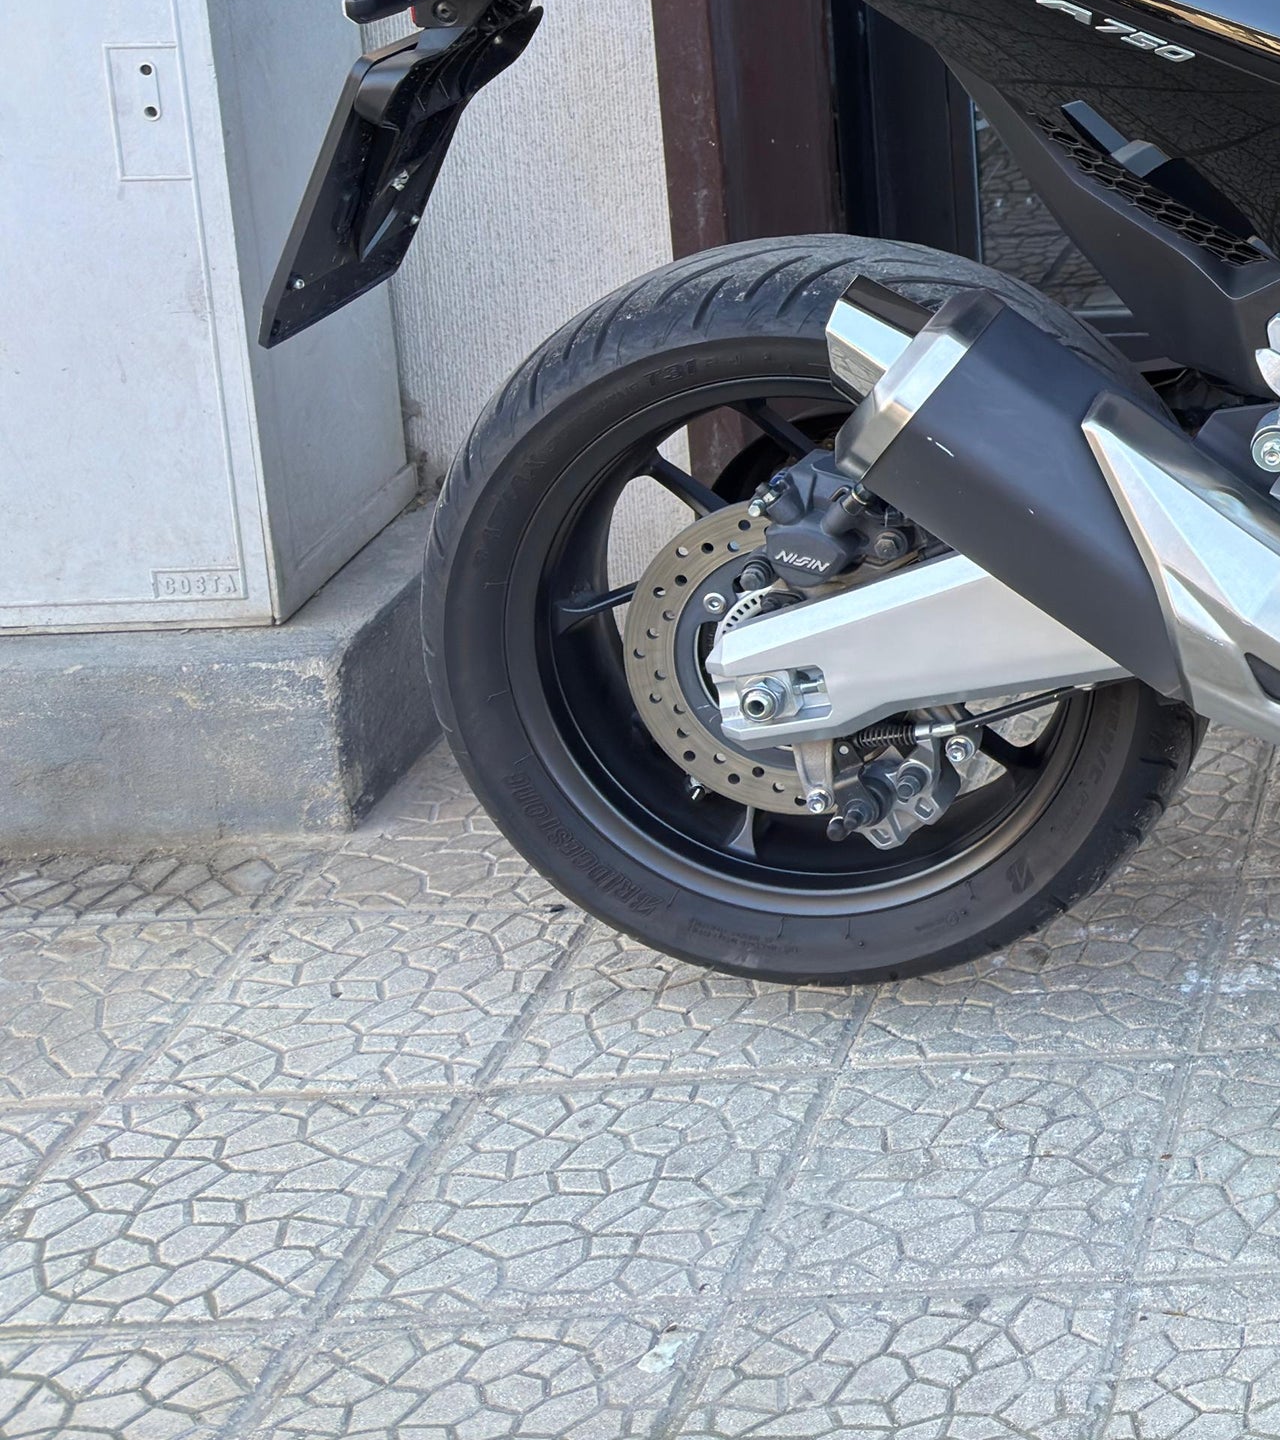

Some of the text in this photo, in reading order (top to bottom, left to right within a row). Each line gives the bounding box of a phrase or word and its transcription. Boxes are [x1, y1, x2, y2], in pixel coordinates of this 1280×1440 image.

[1095, 17, 1197, 64] 750
[163, 574, 239, 596] COSTA
[501, 770, 666, 917] BRIDGESTONE
